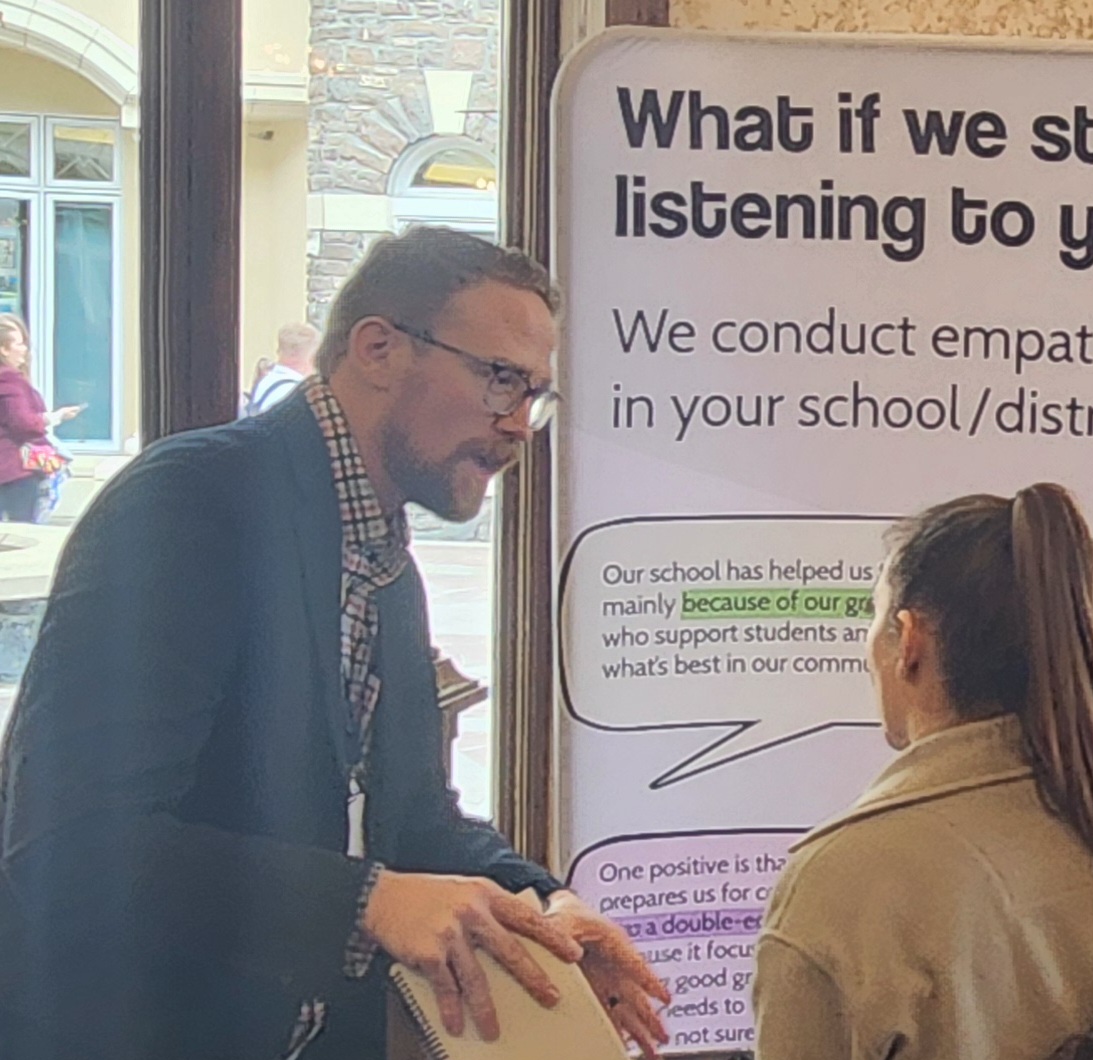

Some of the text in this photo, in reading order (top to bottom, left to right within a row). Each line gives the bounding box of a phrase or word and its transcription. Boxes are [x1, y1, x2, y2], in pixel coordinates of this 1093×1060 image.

[617, 86, 814, 151] What
[837, 93, 881, 153] if
[904, 108, 1007, 158] we
[614, 175, 926, 262] listening
[951, 187, 1035, 247] to
[612, 308, 695, 354] We
[712, 306, 916, 357] conduct
[612, 384, 654, 428] in
[671, 391, 784, 441] your
[602, 564, 644, 585] Our
[650, 560, 721, 584] school
[726, 560, 763, 582] has
[769, 559, 843, 586] helped
[849, 563, 873, 581] us
[602, 592, 676, 619] mainly
[682, 591, 771, 613] because
[775, 589, 799, 611] of
[803, 593, 838, 612] our
[602, 621, 869, 649] who support students an
[602, 655, 668, 679] what's
[675, 653, 721, 675] best
[726, 652, 747, 673] in
[751, 655, 787, 674] our
[600, 854, 786, 883] One positive is tha
[600, 889, 687, 913] prepares
[693, 888, 716, 904] us
[722, 883, 750, 901] for
[645, 922, 657, 935] a
[687, 943, 700, 960] it
[675, 968, 727, 994] good
[724, 998, 745, 1014] to
[675, 1027, 754, 1045] not sure
